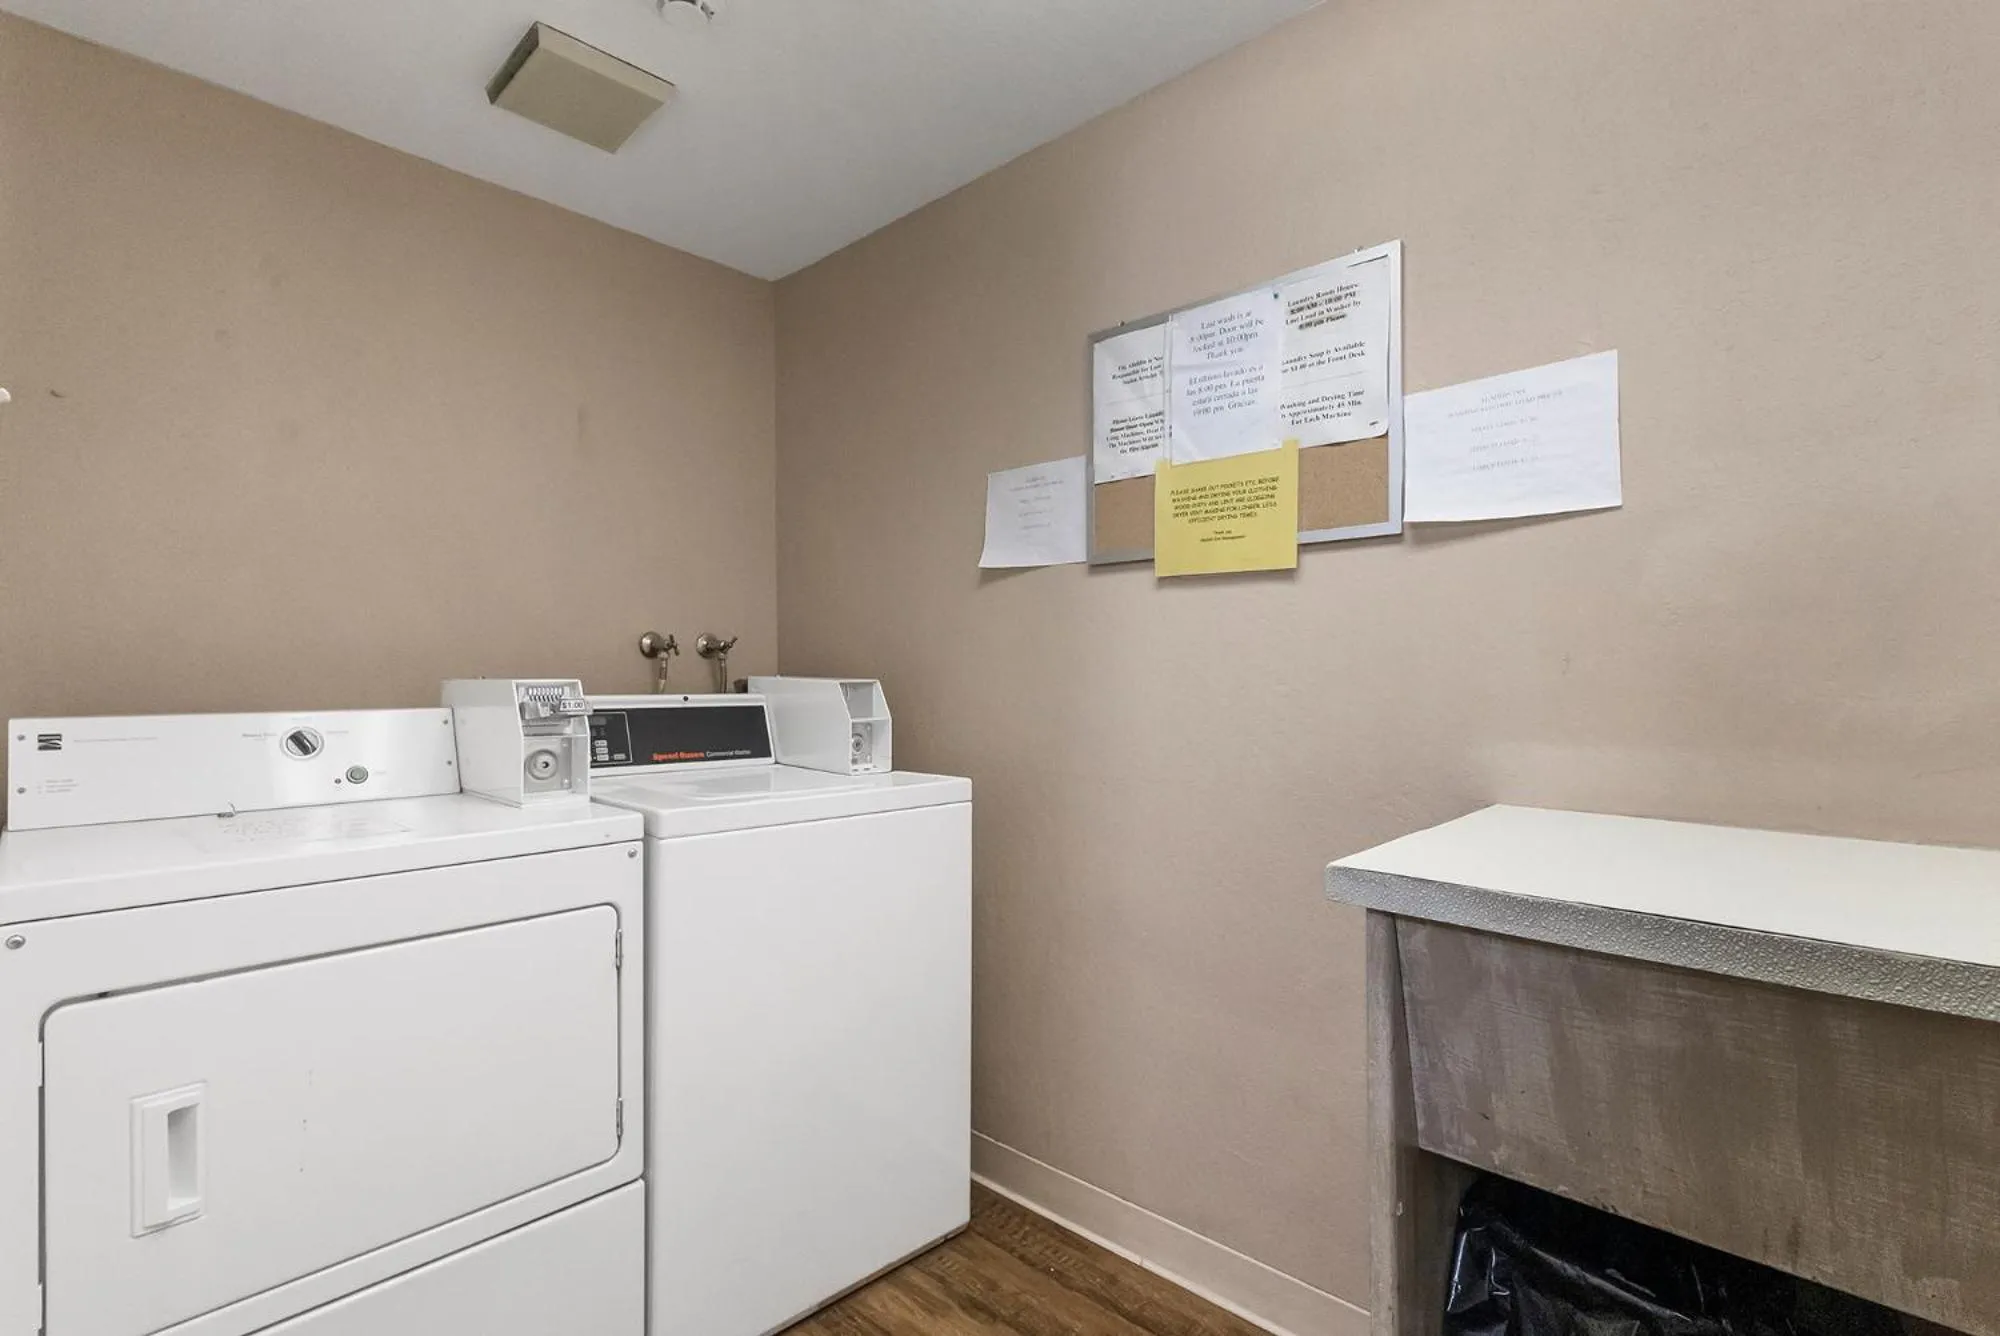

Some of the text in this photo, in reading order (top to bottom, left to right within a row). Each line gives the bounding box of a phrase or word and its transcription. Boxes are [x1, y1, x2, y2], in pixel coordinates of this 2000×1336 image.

[1287, 296, 1315, 308] Laundry
[1316, 289, 1335, 299] Room
[1300, 312, 1317, 321] Load
[1326, 302, 1351, 313] Washer
[1200, 320, 1215, 329] Last
[1217, 313, 1235, 324] wash
[1219, 326, 1236, 335] Door
[1239, 319, 1253, 329] will
[1254, 318, 1264, 326] be
[1207, 348, 1227, 360] Thank
[1327, 353, 1346, 364] Front
[1348, 349, 1365, 359] Desk
[1241, 374, 1265, 387] puerta
[1308, 397, 1320, 405] and
[1321, 393, 1346, 402] Drying
[1347, 390, 1365, 398] Time
[1303, 413, 1321, 423] Each
[1322, 411, 1352, 420] Machine
[1170, 488, 1189, 496] PLEASE
[1208, 483, 1219, 491] OUT
[1220, 480, 1244, 489] POCKETS
[1210, 491, 1231, 499] DRYING
[1231, 488, 1247, 496] YOUR
[652, 751, 680, 761] Speed
